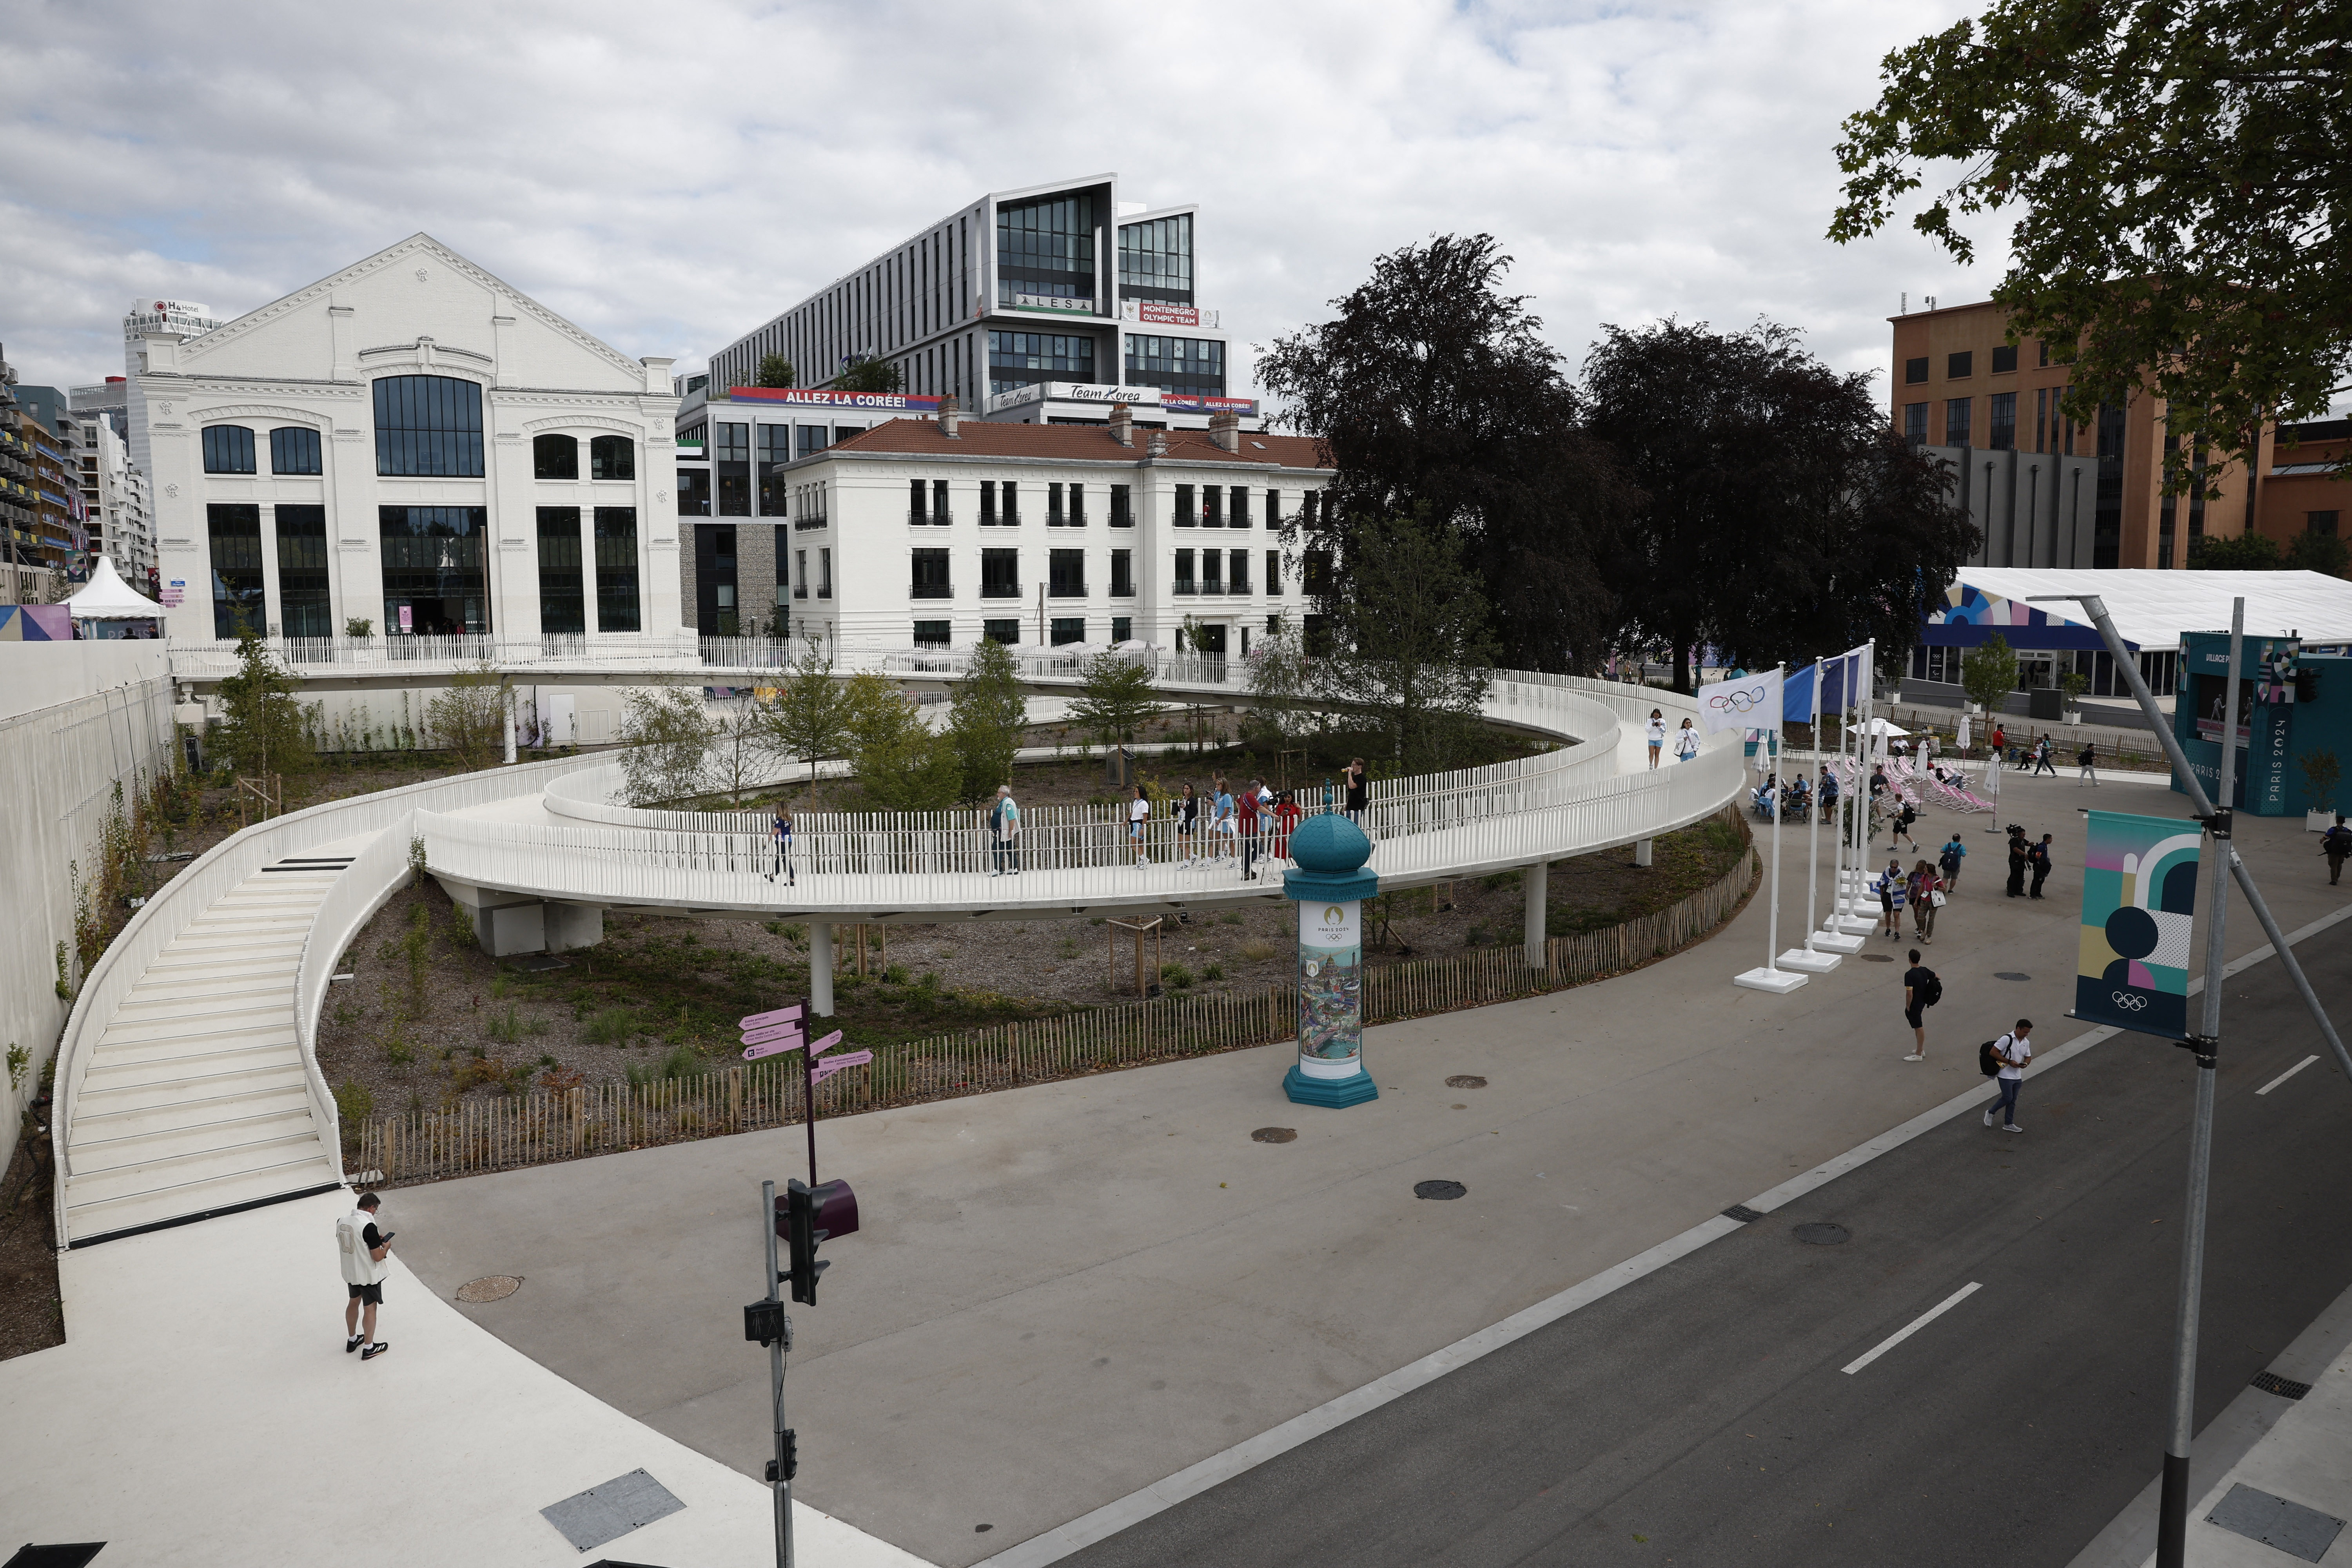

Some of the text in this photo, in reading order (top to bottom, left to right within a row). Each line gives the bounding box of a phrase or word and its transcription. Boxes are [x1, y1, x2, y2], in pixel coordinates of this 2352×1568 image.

[1037, 297, 1073, 309] LES
[1143, 305, 1195, 316] MONTENEGRO
[1143, 314, 1195, 324] OLYMPIC TEAM
[1000, 389, 1032, 408] Team Korea
[1071, 385, 1140, 401] Team Korea
[786, 392, 906, 407] ALLEZ LA CORÉE!
[2206, 653, 2225, 663] VILLAGE
[1292, 885, 1377, 896] SPECTACLES SPECTACLES
